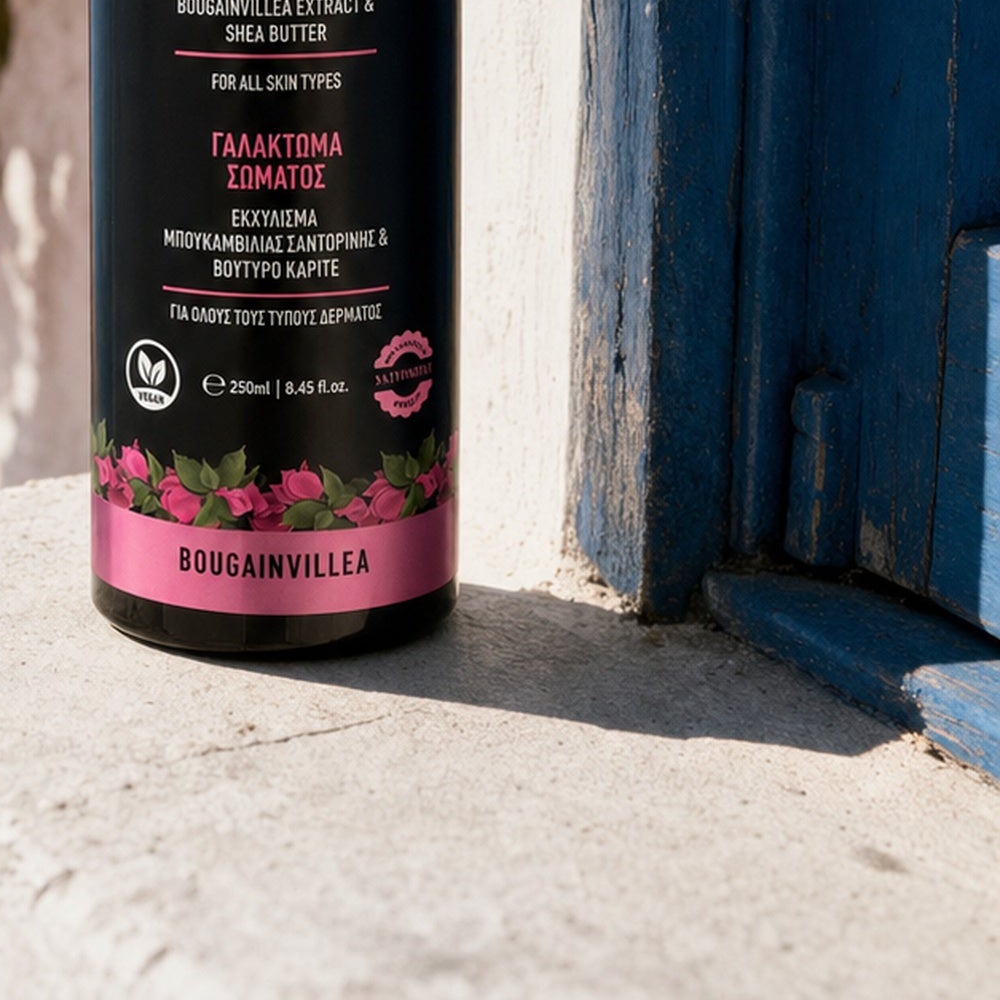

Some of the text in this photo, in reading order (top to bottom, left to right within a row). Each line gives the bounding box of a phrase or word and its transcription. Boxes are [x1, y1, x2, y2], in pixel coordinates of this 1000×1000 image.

[226, 24, 327, 43] SHEA BUTTER
[212, 72, 342, 92] FOR ALL SKIN TYPES
[211, 132, 343, 159] ΓΑΛΑΚΤΩΜΑ
[227, 164, 326, 190] ΣΩΜΑΤΟΣ
[232, 209, 318, 228] ΕΚΧΥΛΙΣΜΑ
[163, 227, 389, 254] ΜΠΟΥΚΑΜΒΙΛΙΑΣ ΣΑΝΤΟΡΙΝΗΣ &
[213, 258, 340, 279] ΒΟΥΤΥΡΟ ΚΑΡΙΤΕ
[170, 303, 189, 321] ΓΙΑ
[191, 306, 231, 325] ΟΛΟΥΣ
[234, 309, 265, 326] ΤΟΥΣ
[268, 309, 317, 326] ΤΥΠΟΥΣ
[229, 379, 271, 395] 250ml
[285, 380, 315, 396] 8.45
[180, 547, 370, 579] BOUGAINVILLEA
